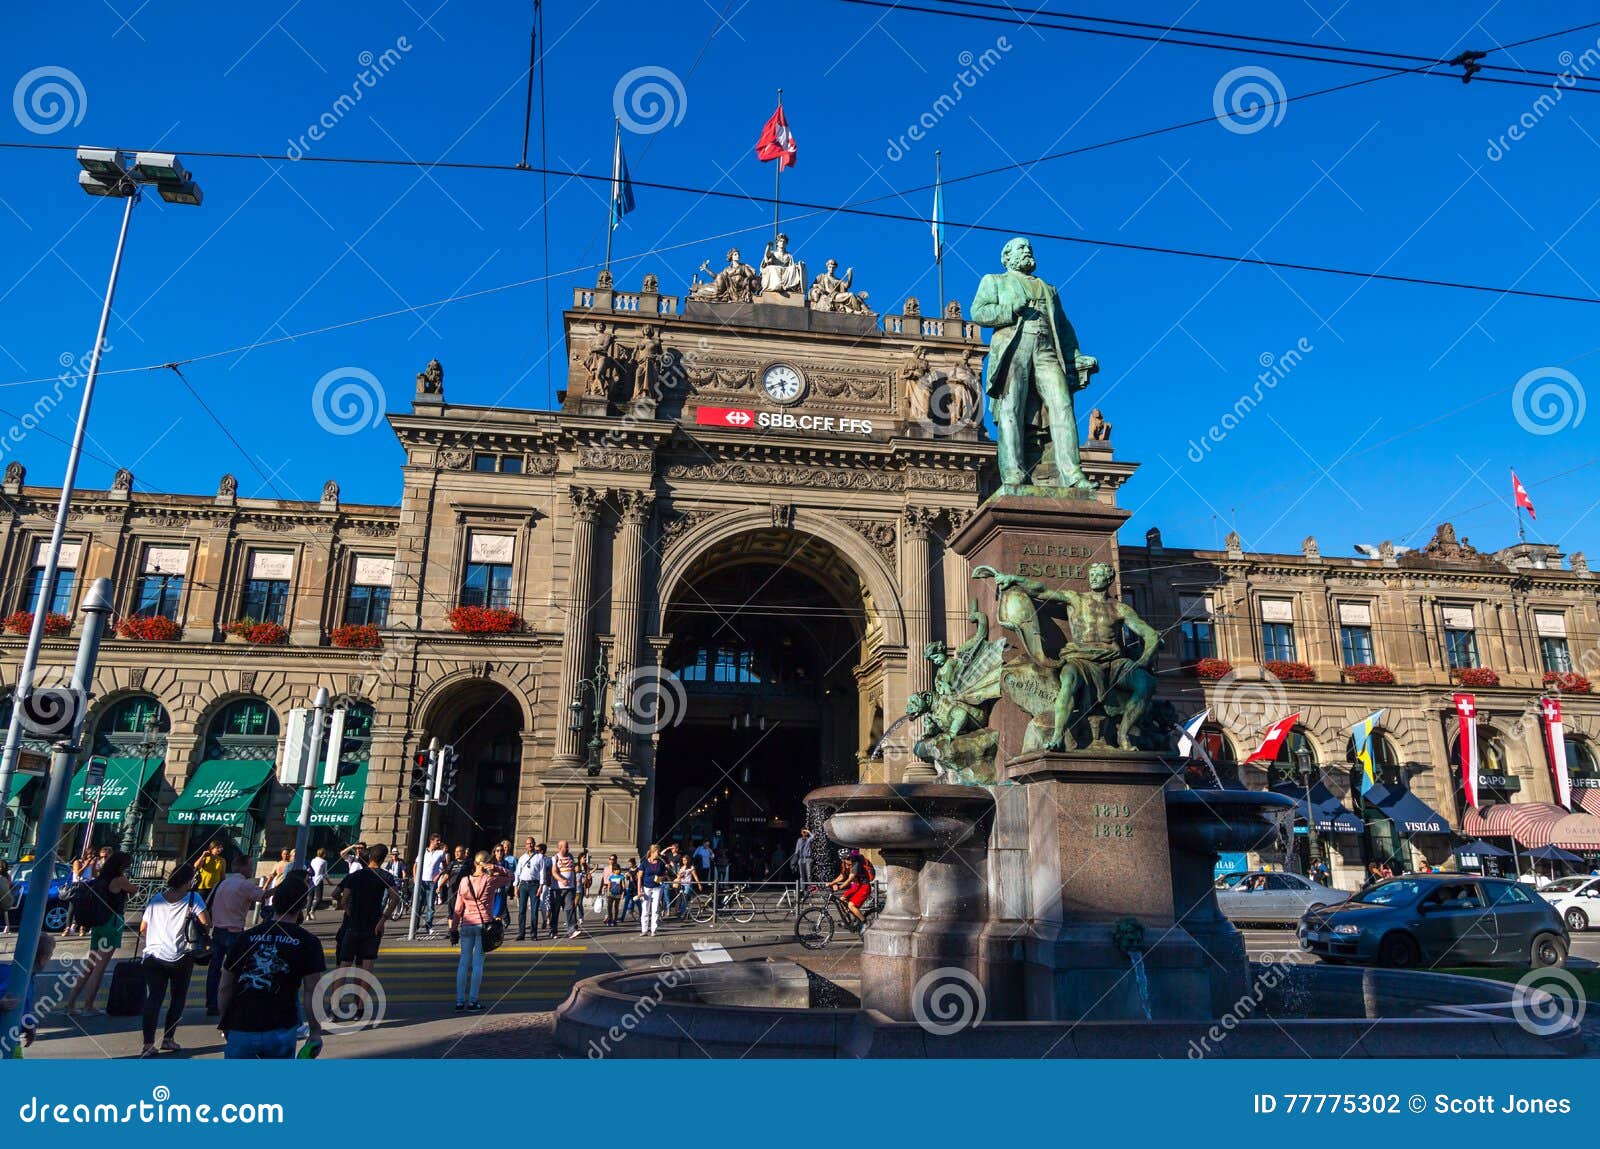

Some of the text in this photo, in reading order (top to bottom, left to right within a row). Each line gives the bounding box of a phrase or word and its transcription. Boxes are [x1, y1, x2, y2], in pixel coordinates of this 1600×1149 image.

[758, 412, 873, 434] SBB CFF FFS
[1023, 543, 1093, 559] ALFRED
[1017, 562, 1088, 580] ESCHE
[1479, 775, 1506, 785] CAPO
[1093, 803, 1131, 818] 1819
[1093, 823, 1134, 838] 1882
[1405, 822, 1441, 832] VISILAB
[249, 934, 300, 946] VALE TUDO
